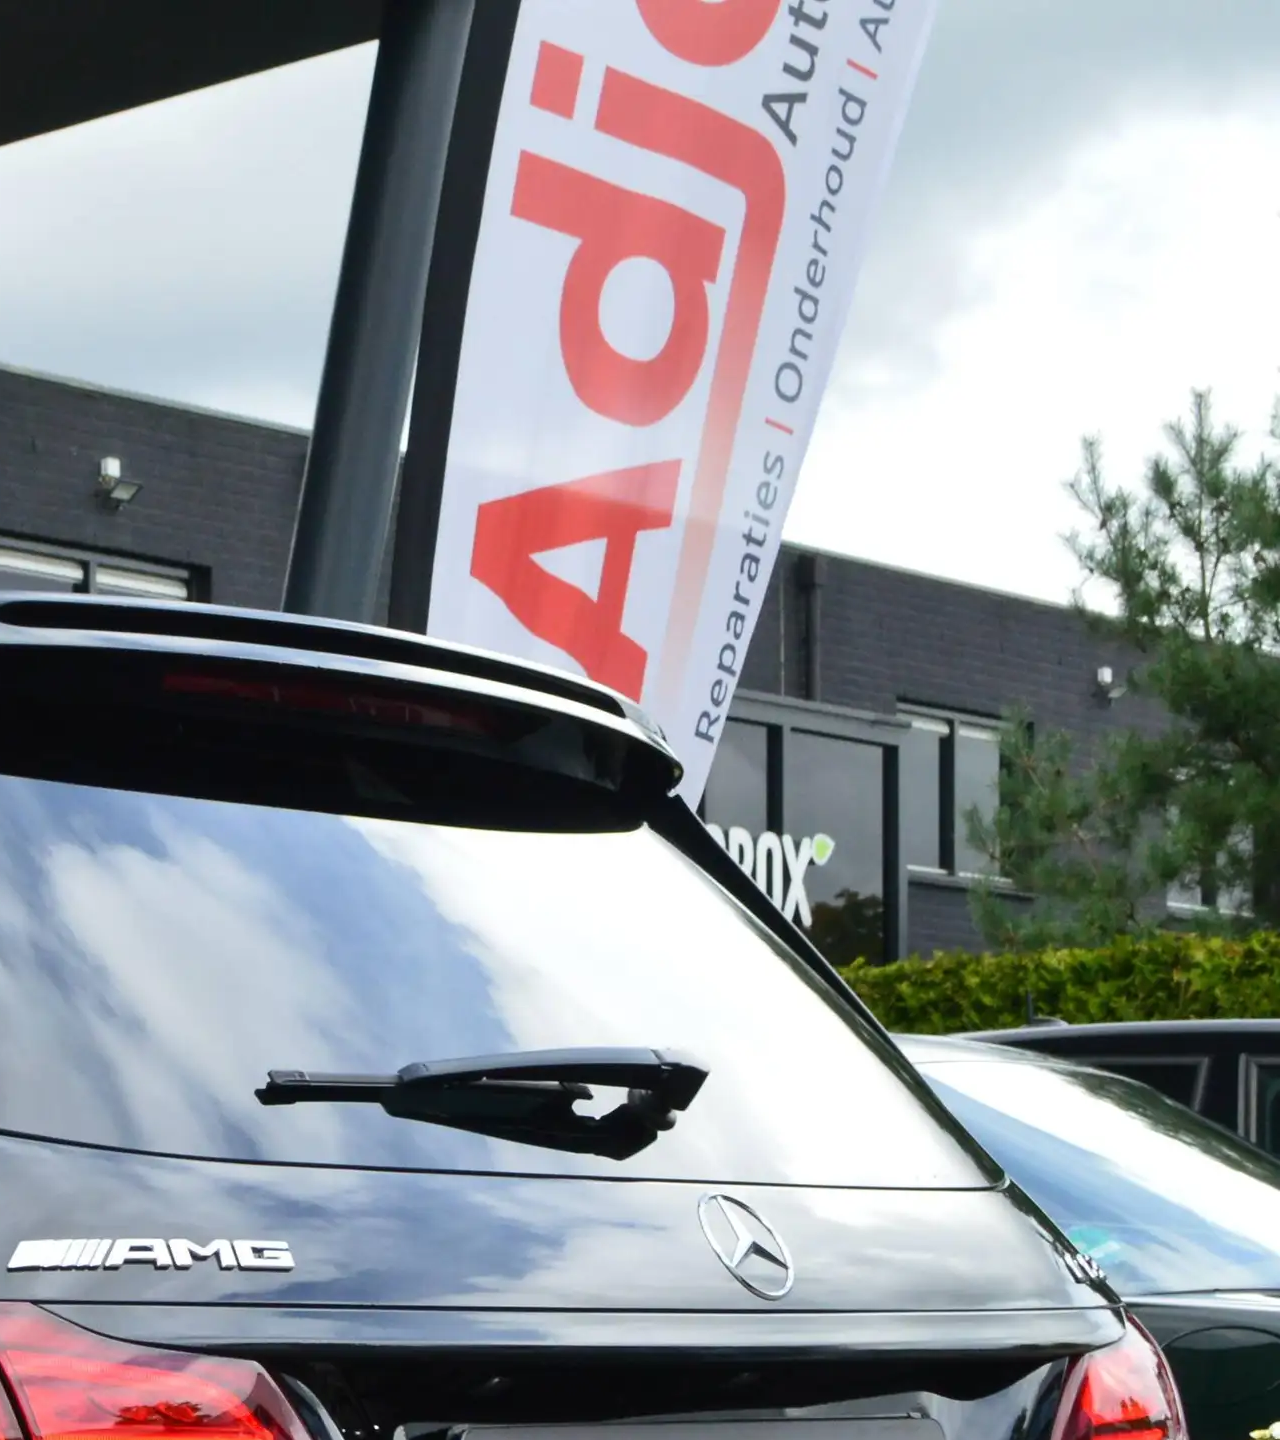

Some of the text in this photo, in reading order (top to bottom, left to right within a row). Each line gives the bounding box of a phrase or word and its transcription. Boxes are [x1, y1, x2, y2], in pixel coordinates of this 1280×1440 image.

[761, 0, 834, 148] Aut
[693, 451, 786, 745] Reparaties
[773, 86, 868, 405] Onderhoud
